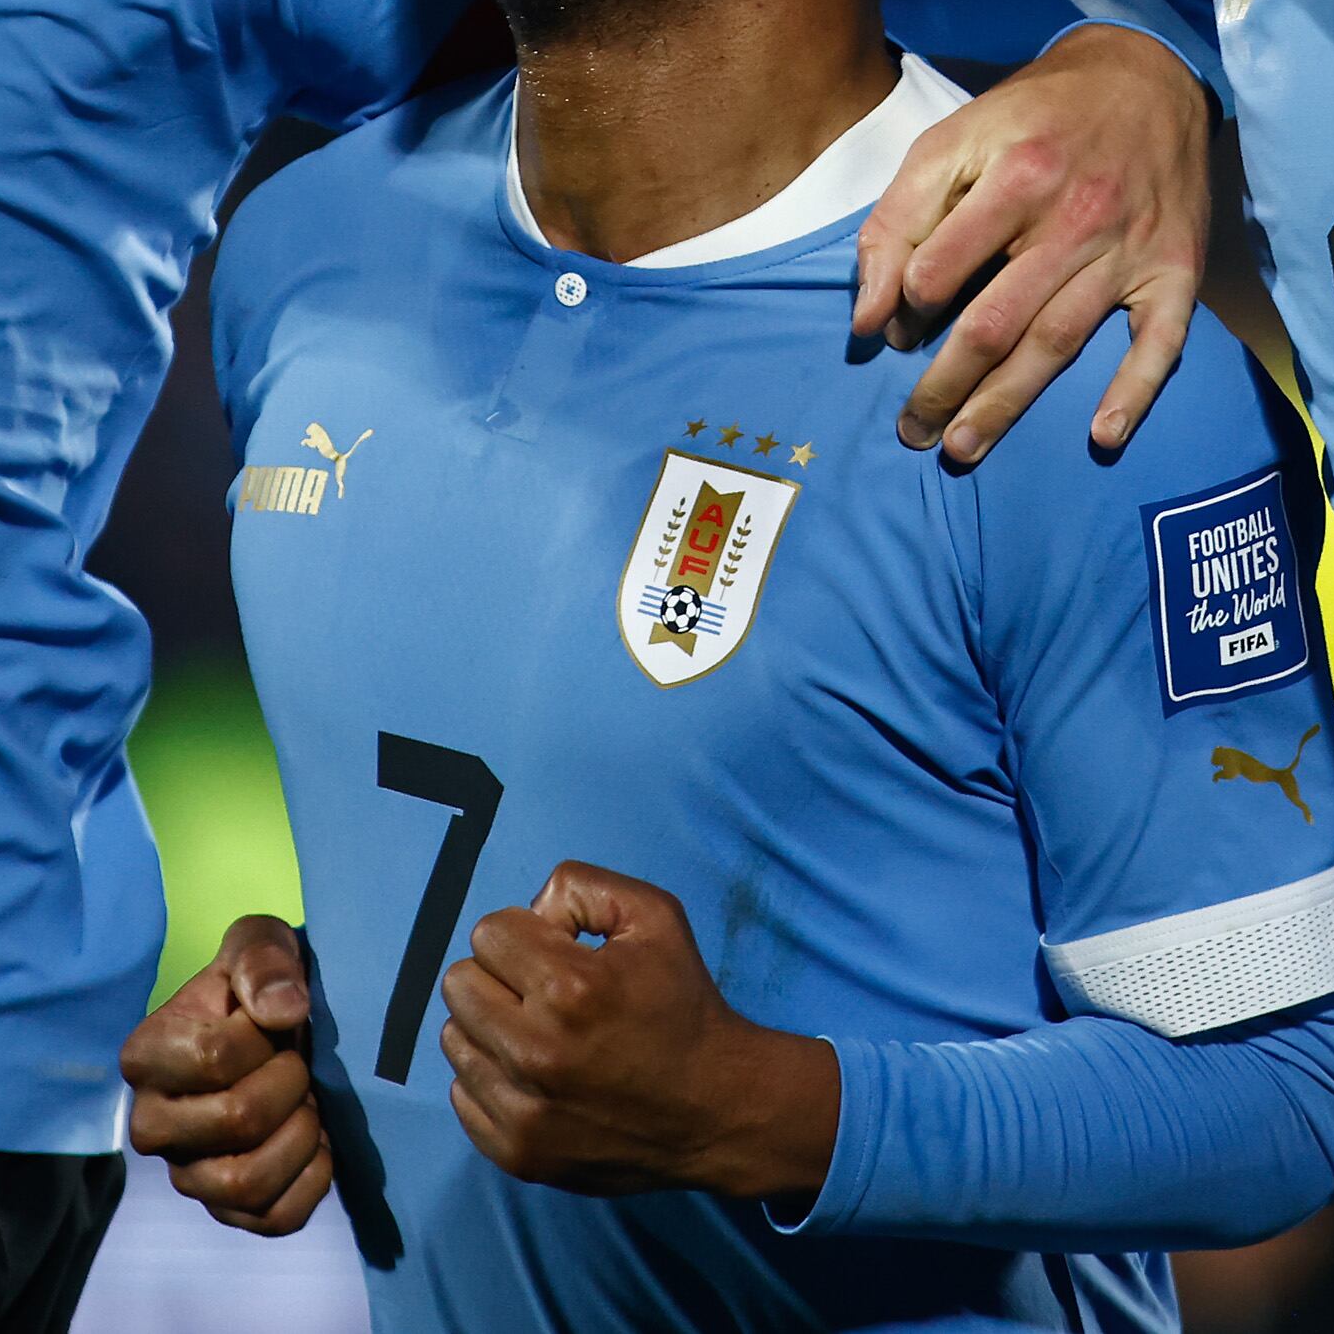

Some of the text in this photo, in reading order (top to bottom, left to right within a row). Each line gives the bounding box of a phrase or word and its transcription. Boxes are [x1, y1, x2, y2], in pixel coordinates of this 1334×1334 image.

[678, 503, 724, 577] AUF
[1188, 507, 1276, 560] FOOTBALL
[1191, 536, 1280, 599] UNITES
[1186, 572, 1286, 634] the World
[1228, 632, 1269, 657] FIFA
[374, 730, 504, 1086] 7
